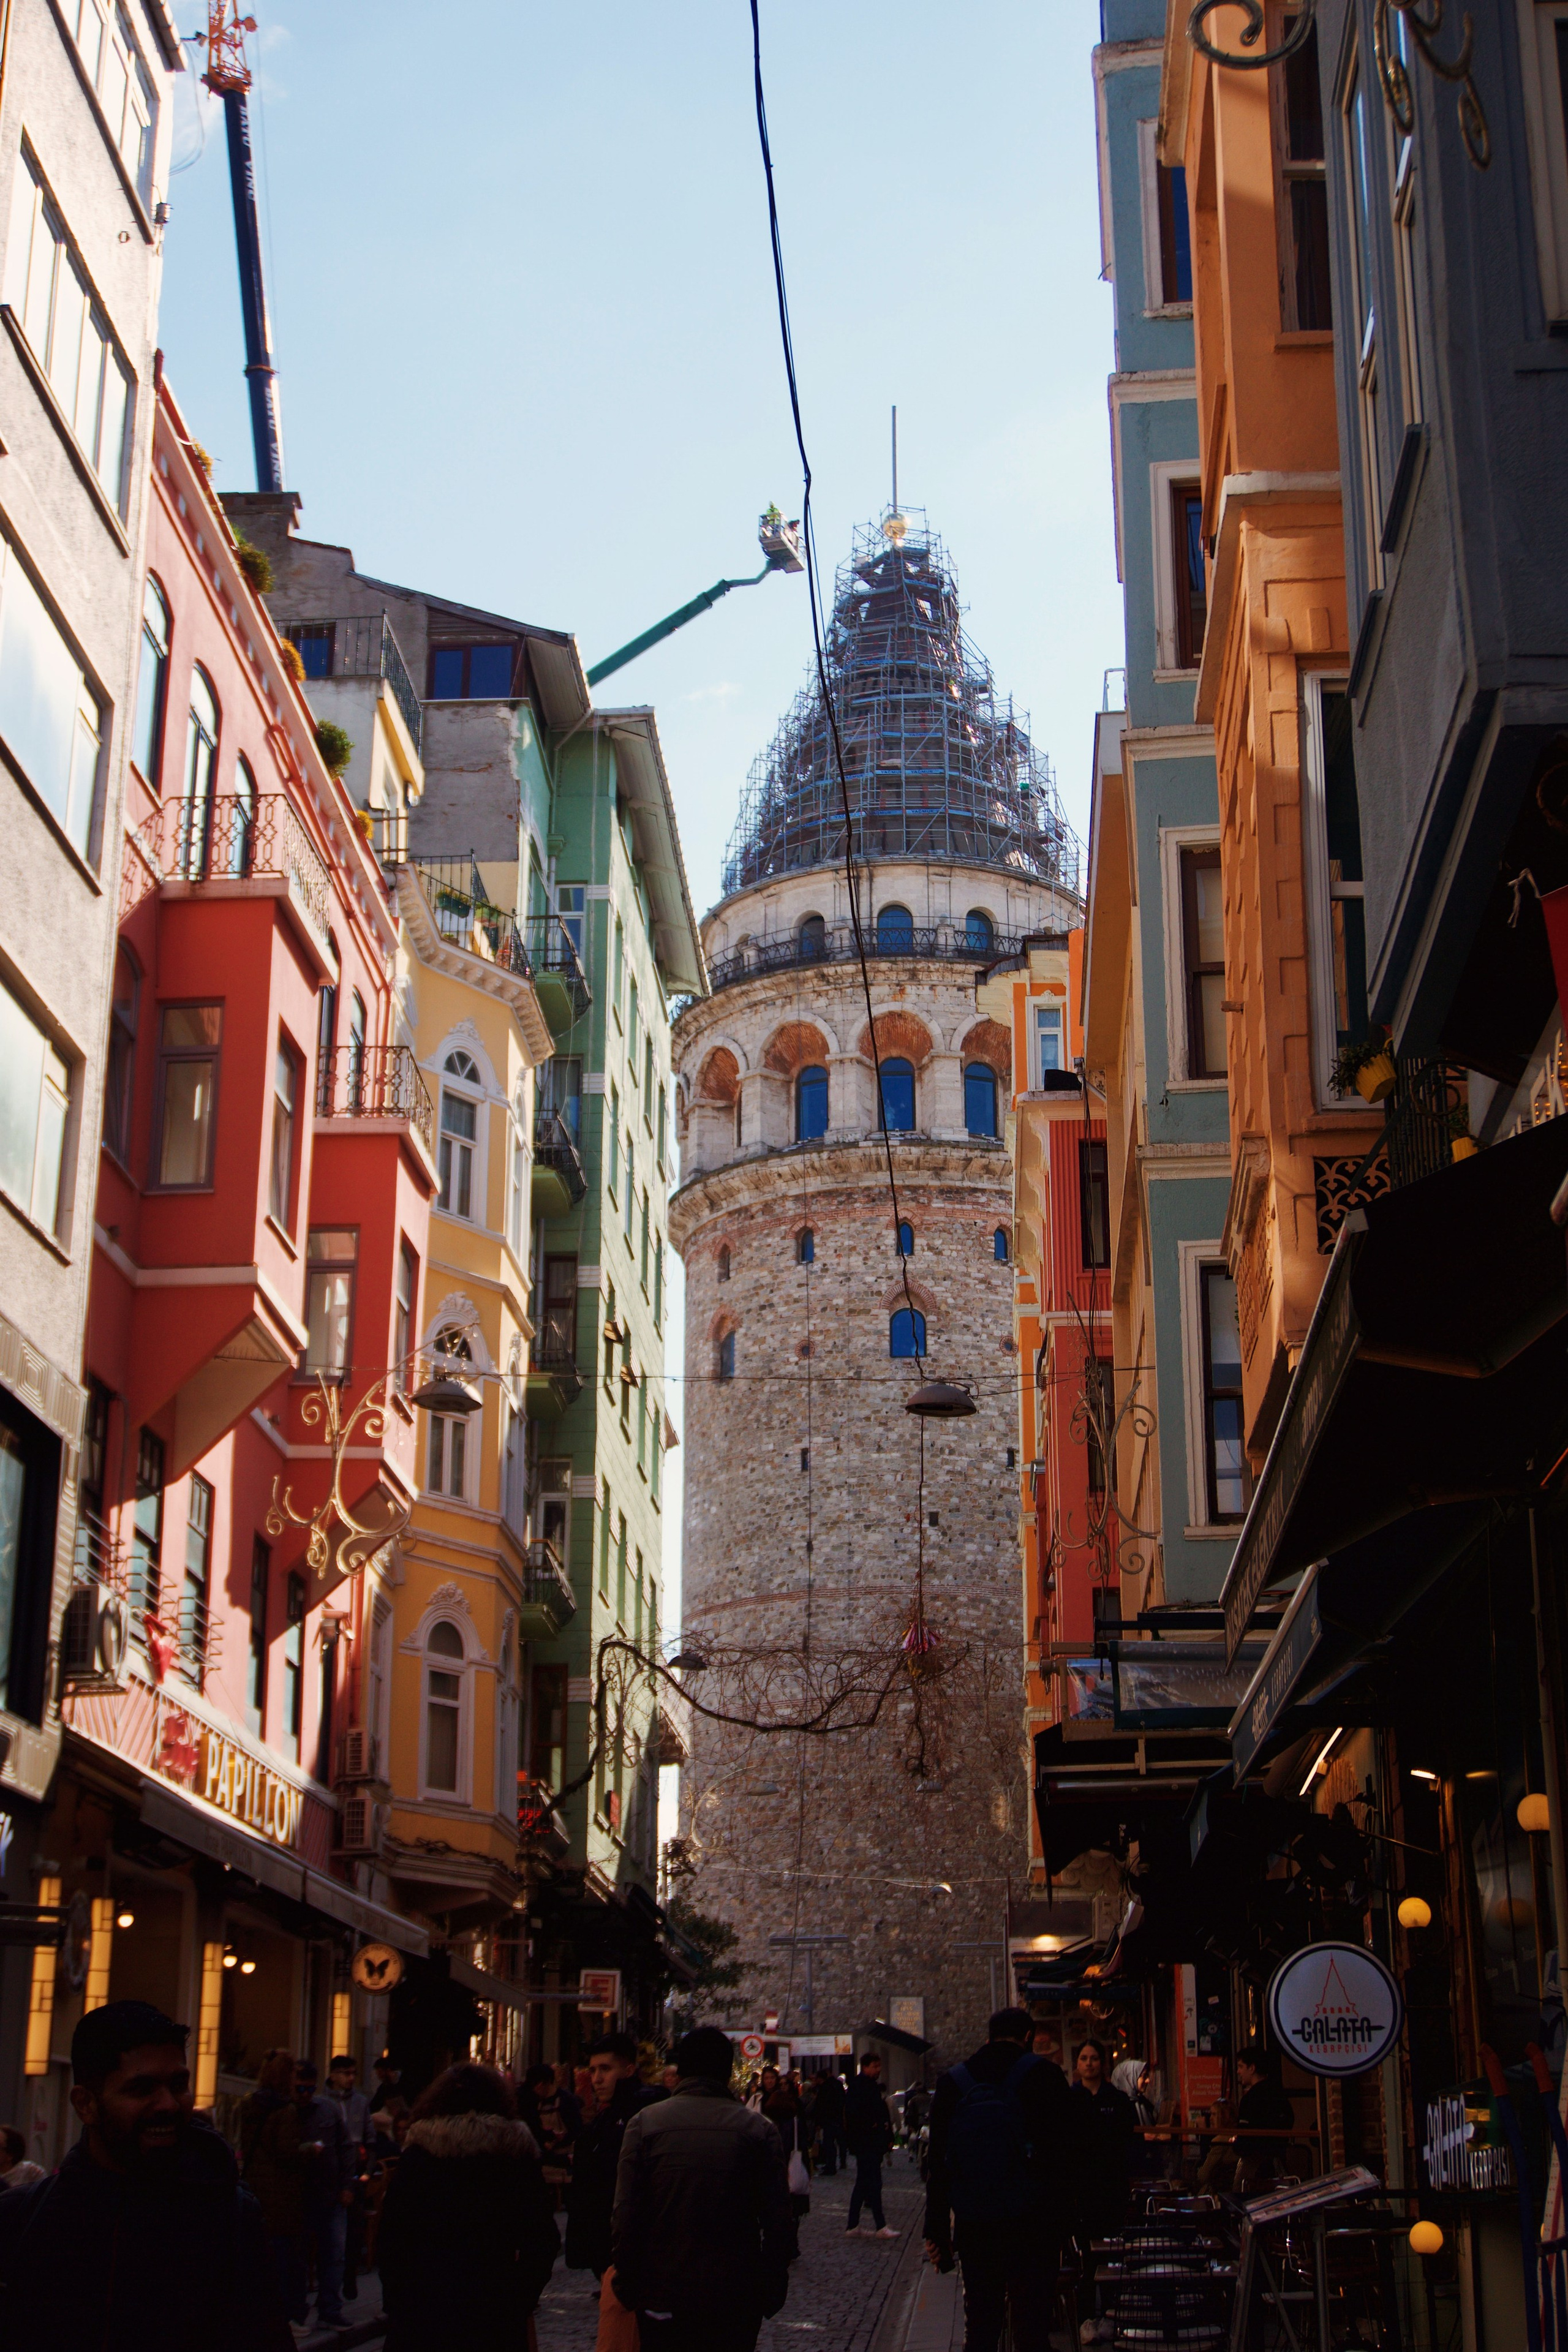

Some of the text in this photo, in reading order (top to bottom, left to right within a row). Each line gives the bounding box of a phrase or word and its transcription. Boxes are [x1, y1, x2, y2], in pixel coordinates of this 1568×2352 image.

[205, 1733, 304, 1849] PAPILLON
[1302, 2016, 1372, 2044] GALATA
[1425, 2092, 1469, 2192] GALATA
